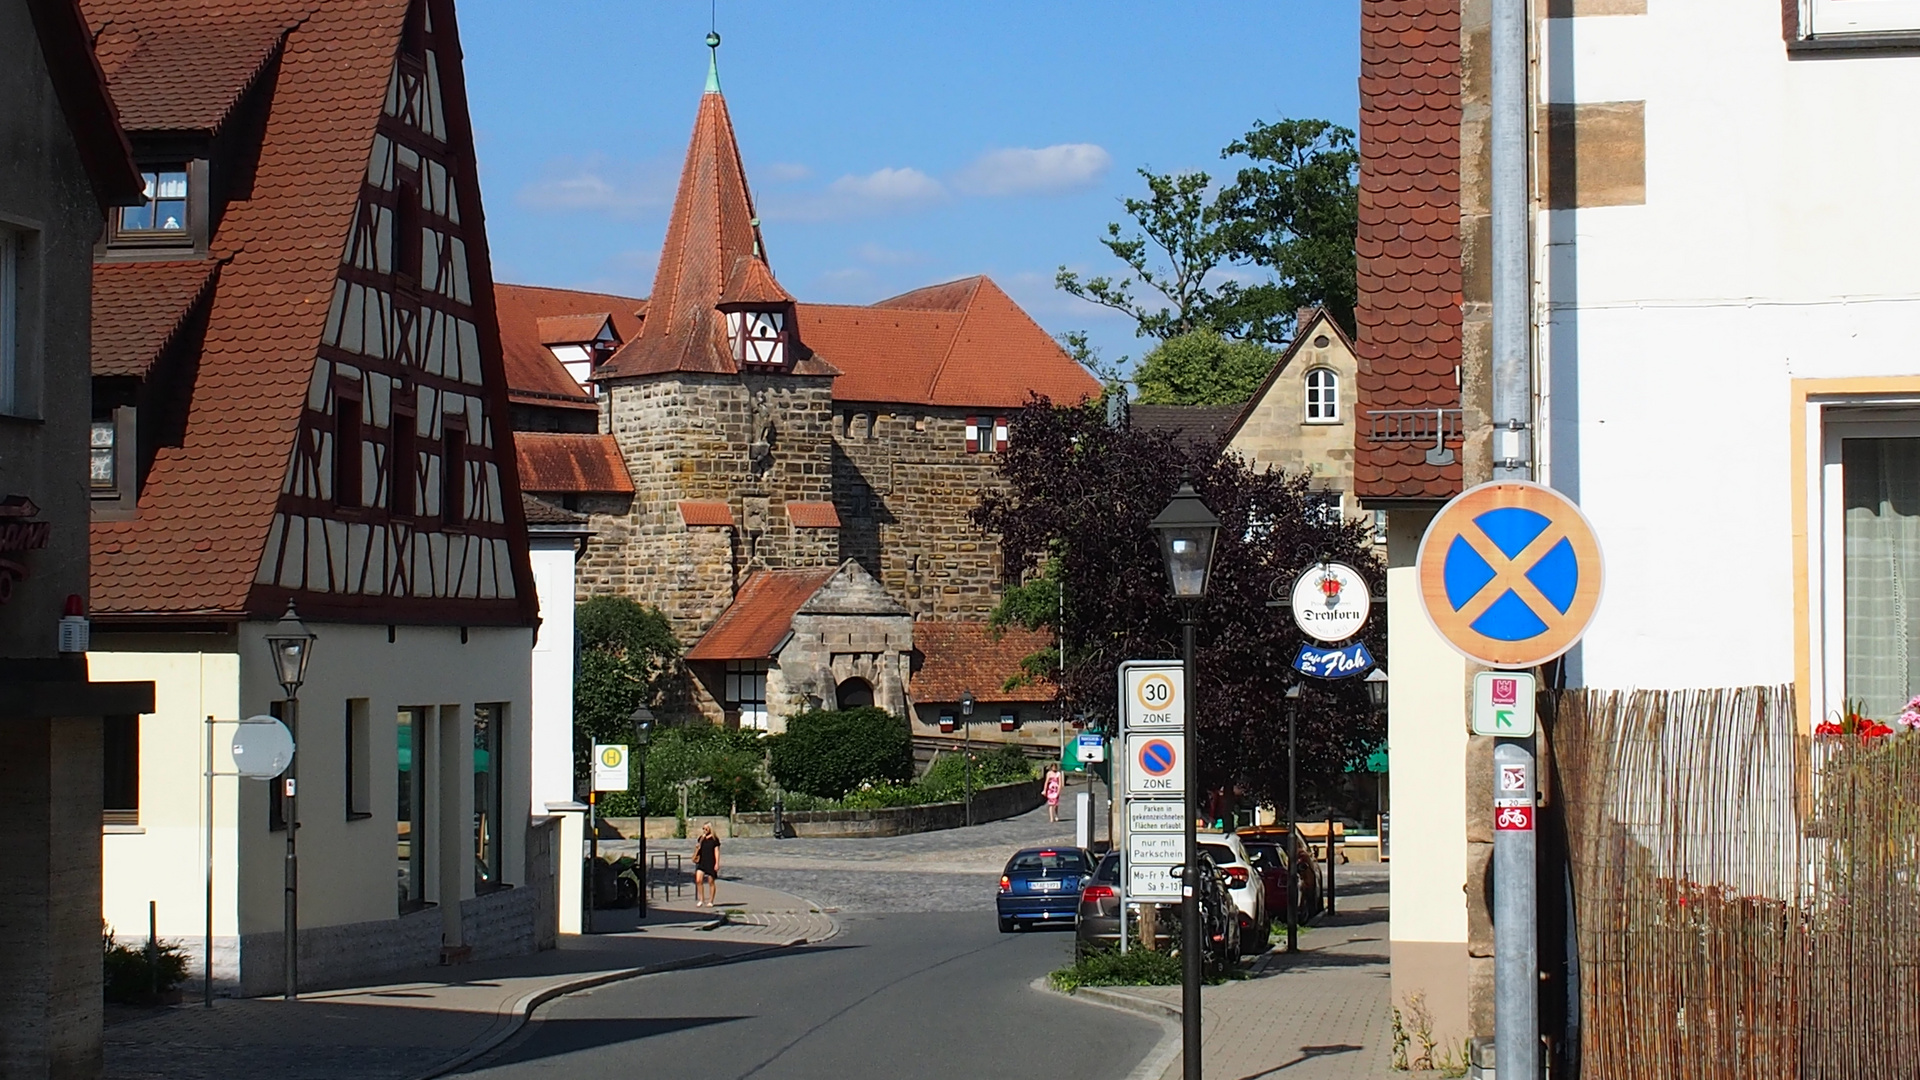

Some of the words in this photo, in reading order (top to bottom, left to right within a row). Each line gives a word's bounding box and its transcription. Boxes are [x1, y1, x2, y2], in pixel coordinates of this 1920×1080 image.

[1320, 648, 1366, 676] Floh
[1145, 684, 1167, 701] 30
[1143, 713, 1171, 723] ZONE
[606, 751, 616, 764] H
[1143, 779, 1172, 788] ZONE
[1132, 814, 1184, 822] gekennzeichneten
[1160, 839, 1175, 847] mit
[1134, 850, 1183, 858] Parkschein
[1133, 871, 1157, 880] Mo-Fr
[1147, 882, 1157, 891] Sa
